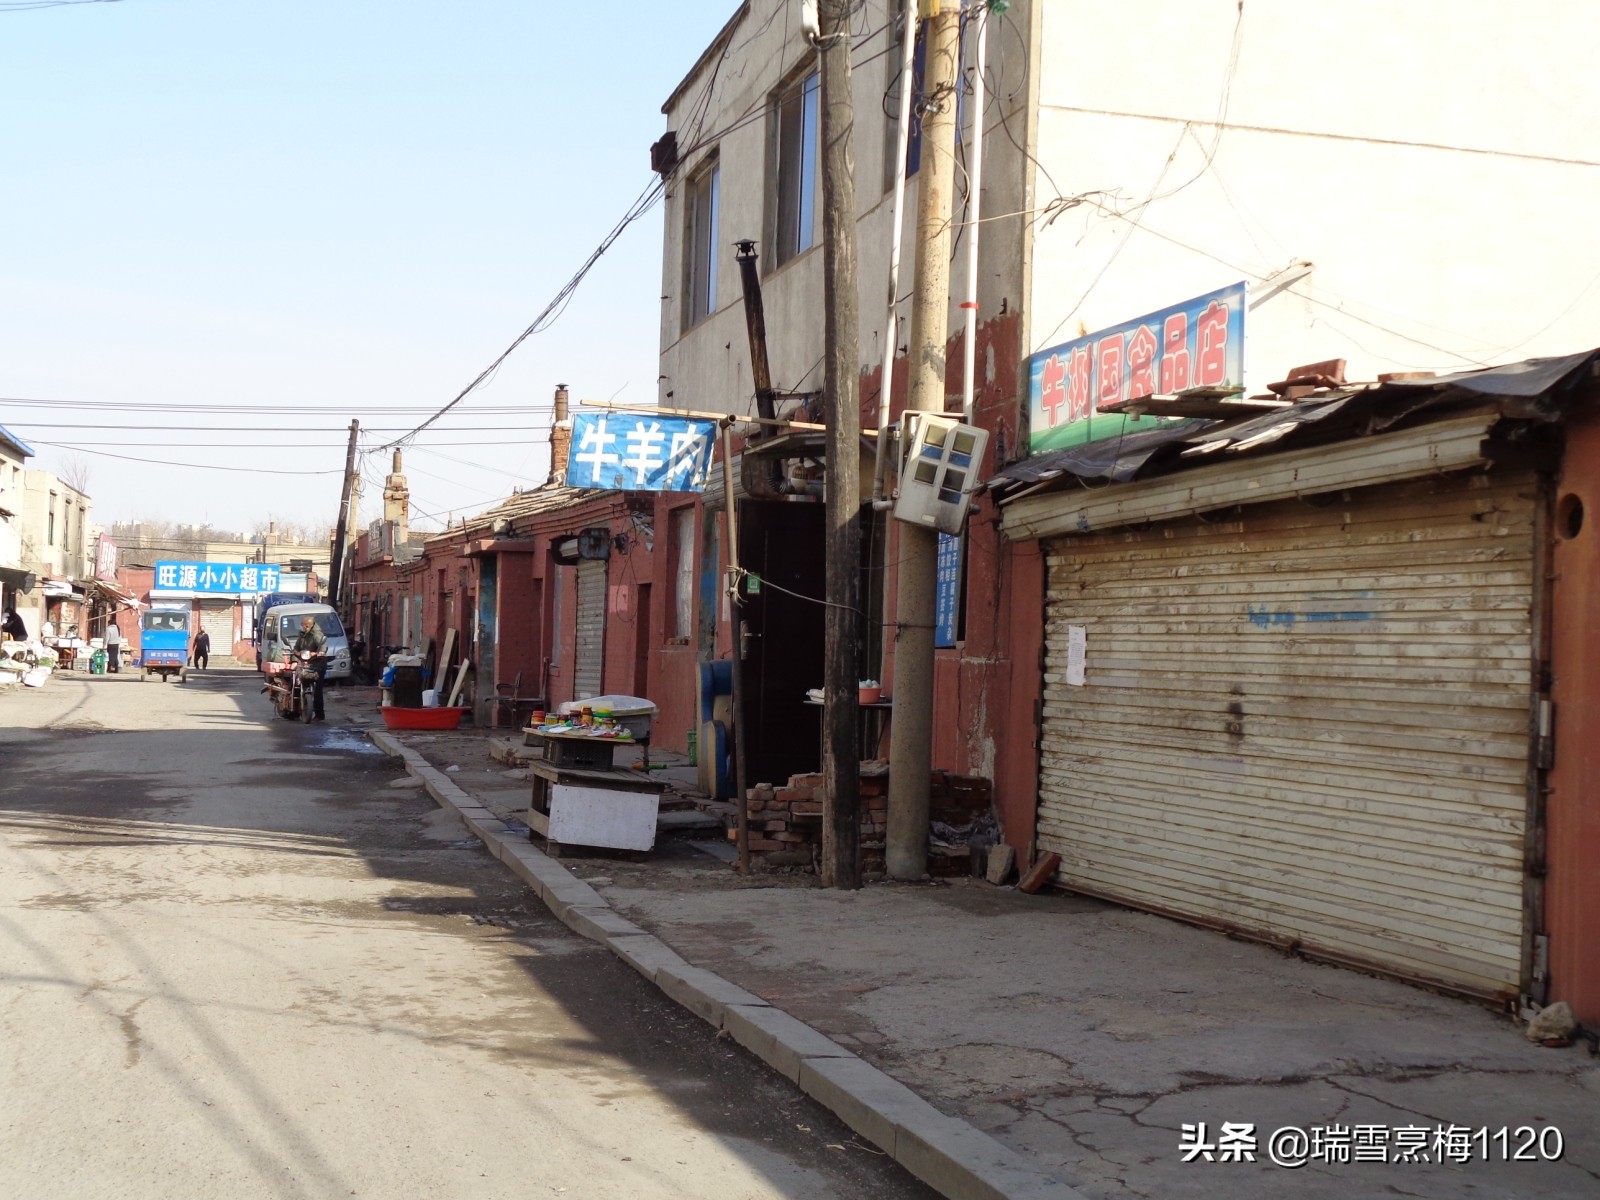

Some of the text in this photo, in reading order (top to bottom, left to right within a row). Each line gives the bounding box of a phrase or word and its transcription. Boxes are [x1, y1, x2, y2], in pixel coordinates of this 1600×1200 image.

[575, 419, 708, 486] 牛羊肉
[158, 564, 279, 591] 旺源小小超市
